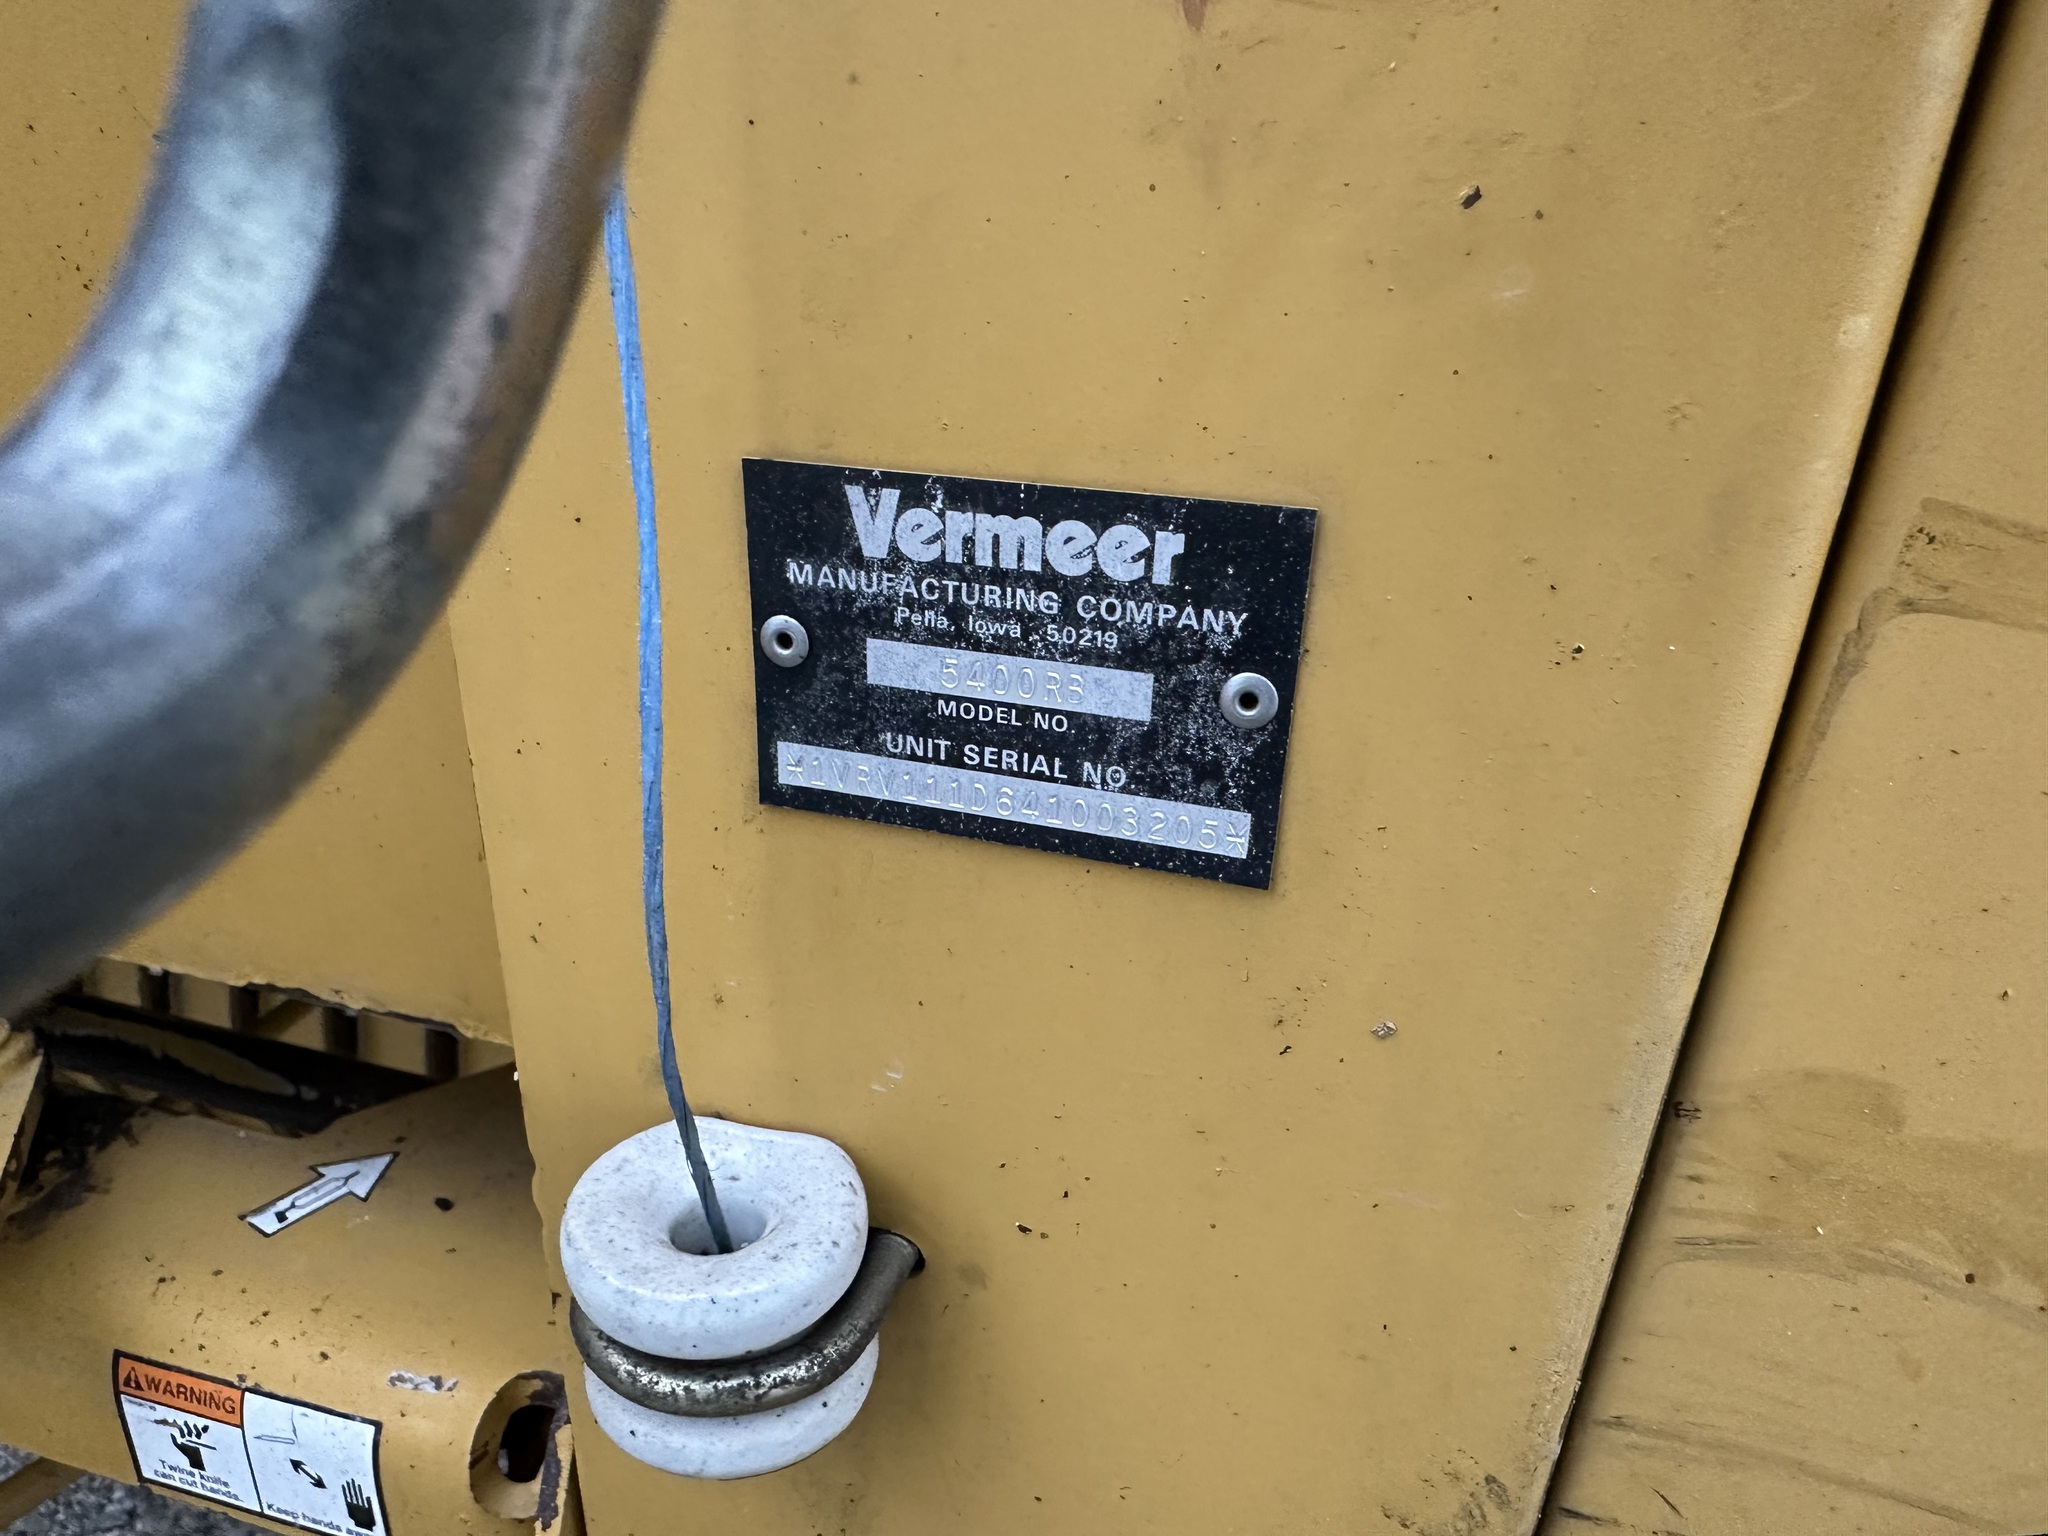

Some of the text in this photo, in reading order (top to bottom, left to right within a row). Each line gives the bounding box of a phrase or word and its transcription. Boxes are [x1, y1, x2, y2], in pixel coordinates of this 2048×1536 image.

[845, 484, 1186, 586] Vermeer
[788, 560, 1249, 637] MANUFACTURING COMPANY
[968, 615, 1021, 638] Iowa
[1046, 624, 1119, 650] 50219
[940, 655, 1085, 704] 5400RB
[937, 699, 1022, 727] MODEL
[886, 733, 951, 760] UNIT
[963, 745, 1068, 780] SERIAL
[144, 1374, 236, 1415] WARNING
[154, 1469, 176, 1482] can
[159, 1459, 231, 1489] Twine knife
[266, 1501, 299, 1519] Keep
[302, 1512, 343, 1532] hands
